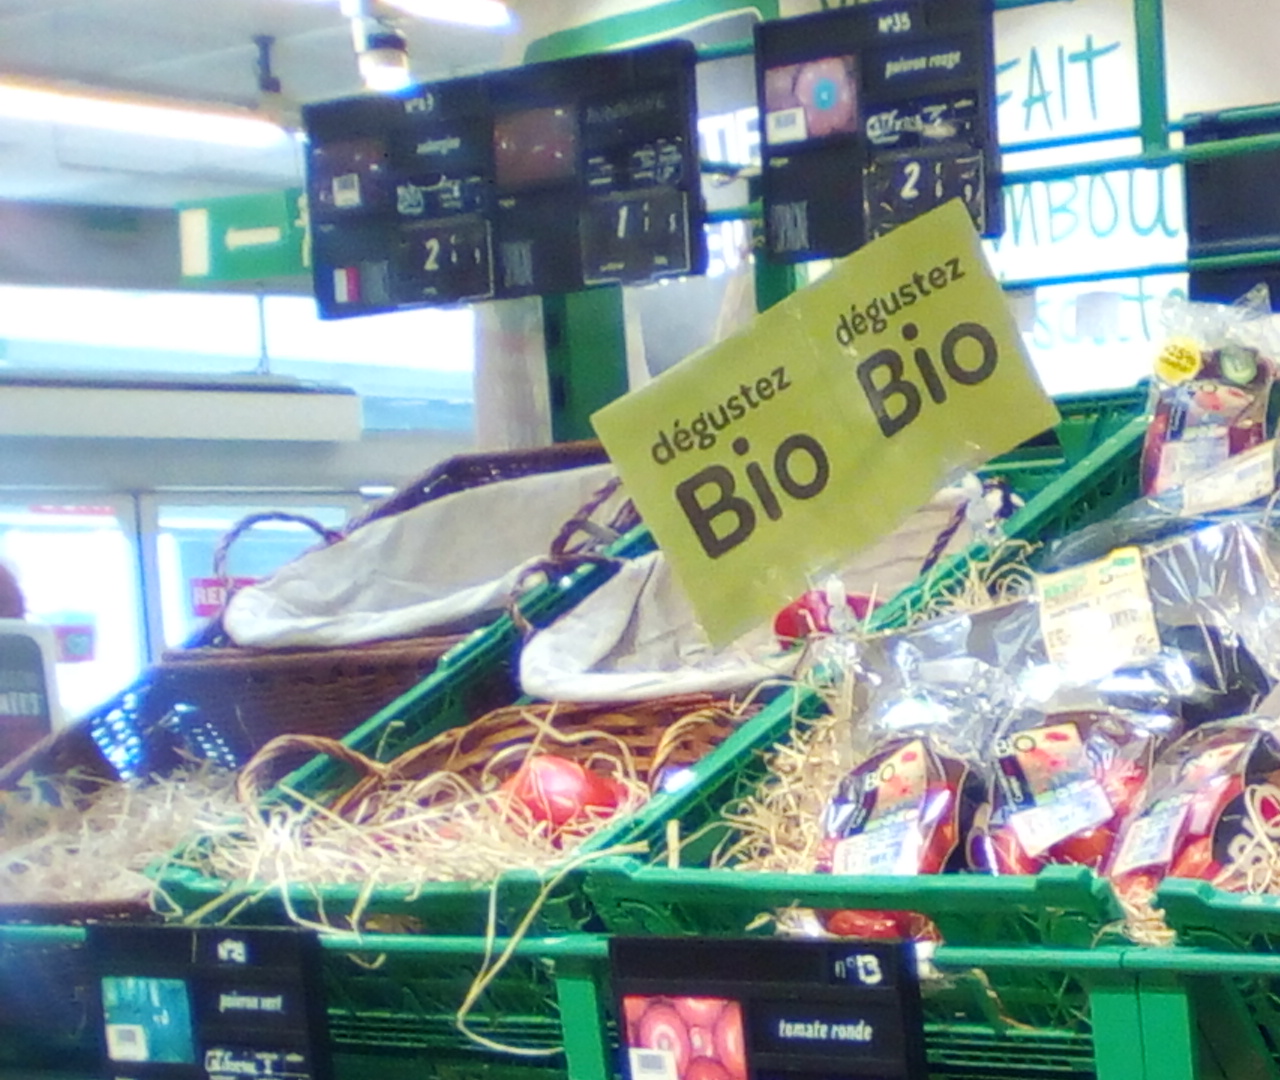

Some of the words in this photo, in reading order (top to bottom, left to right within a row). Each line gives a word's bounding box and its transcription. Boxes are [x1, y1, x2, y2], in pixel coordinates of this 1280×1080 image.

[836, 257, 966, 347] dégustez
[651, 366, 792, 465] dégustez
[856, 322, 998, 438] Bio
[675, 433, 830, 560] Bio
